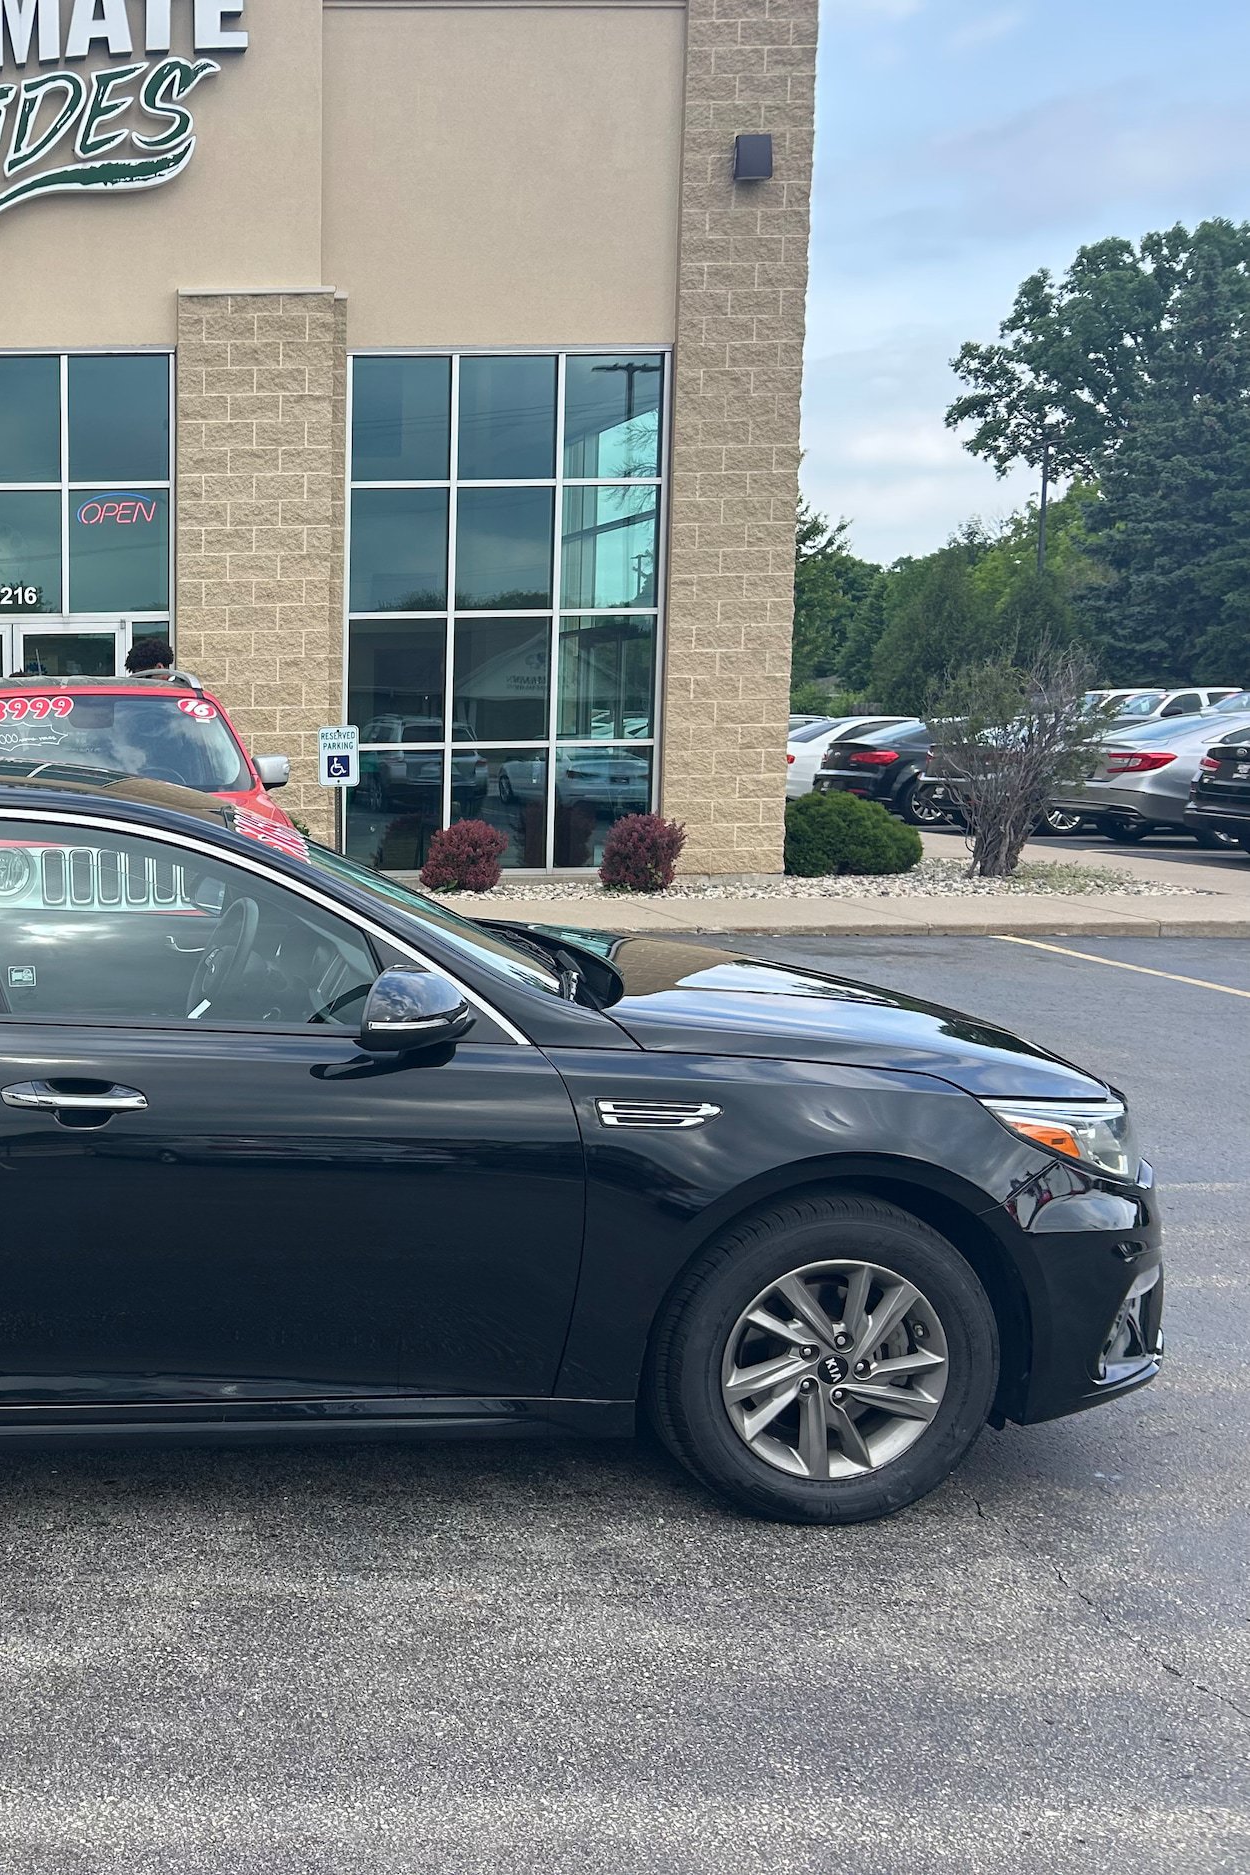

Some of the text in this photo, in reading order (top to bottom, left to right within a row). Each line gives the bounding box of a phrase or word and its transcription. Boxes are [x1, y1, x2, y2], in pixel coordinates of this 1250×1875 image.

[81, 501, 157, 525] OPEN
[183, 700, 209, 717] 16
[320, 731, 356, 741] RESERVED
[322, 741, 354, 751] PARKING
[825, 1357, 842, 1383] KIA
